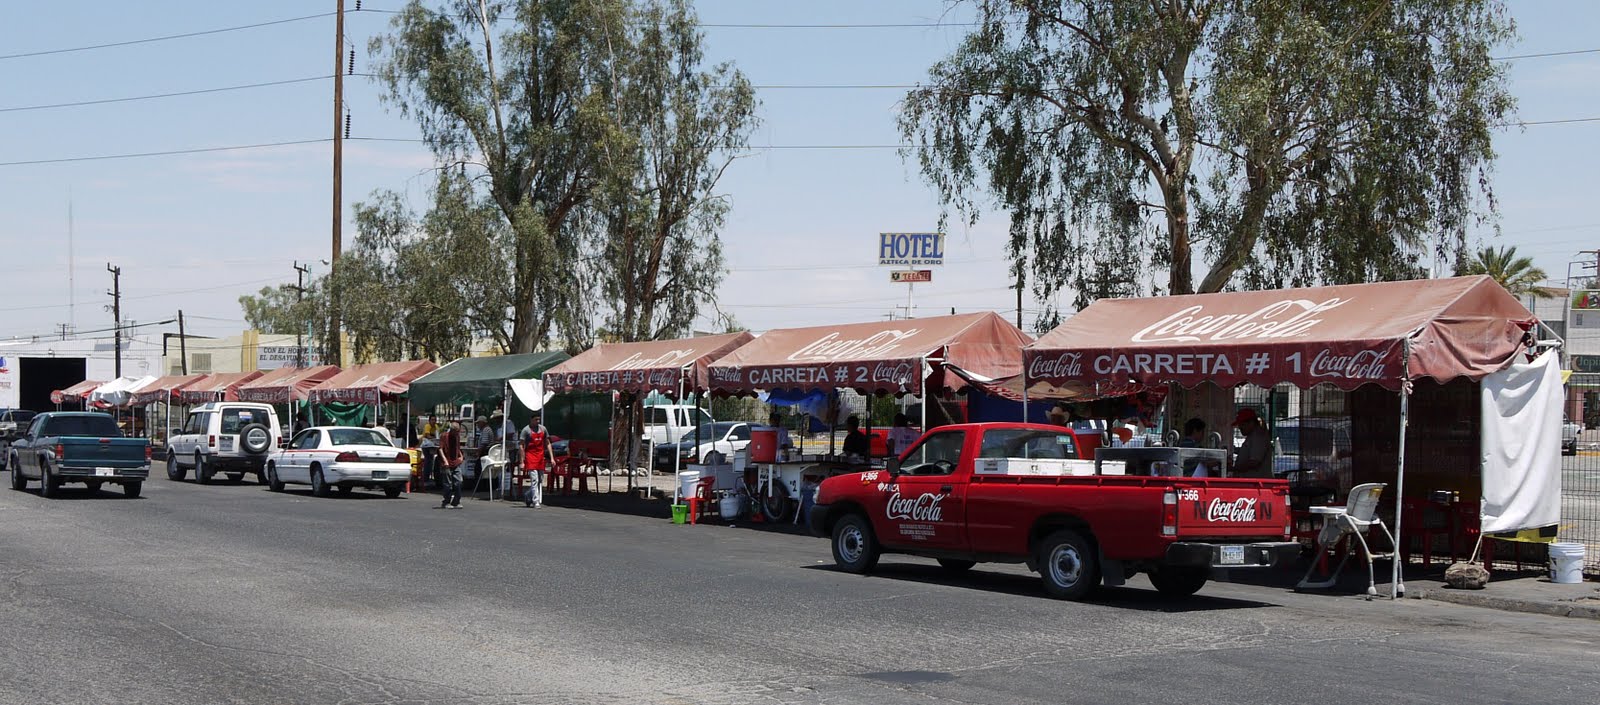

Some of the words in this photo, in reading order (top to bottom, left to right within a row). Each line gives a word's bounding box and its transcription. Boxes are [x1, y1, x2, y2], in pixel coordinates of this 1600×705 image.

[880, 233, 943, 258] HOTEL
[902, 272, 929, 280] TECATE
[1094, 352, 1234, 375] CARRETA
[1246, 352, 1270, 374] #
[1285, 352, 1301, 374] 1
[566, 371, 619, 386] CARRETA
[623, 370, 633, 385] #
[636, 370, 645, 384] 3
[749, 367, 830, 385] CARRETA
[834, 366, 849, 382] #
[855, 366, 869, 383] 2
[322, 389, 350, 399] CARRETA
[1177, 489, 1199, 501] V-366
[1194, 501, 1206, 520] N
[1261, 501, 1272, 520] N
